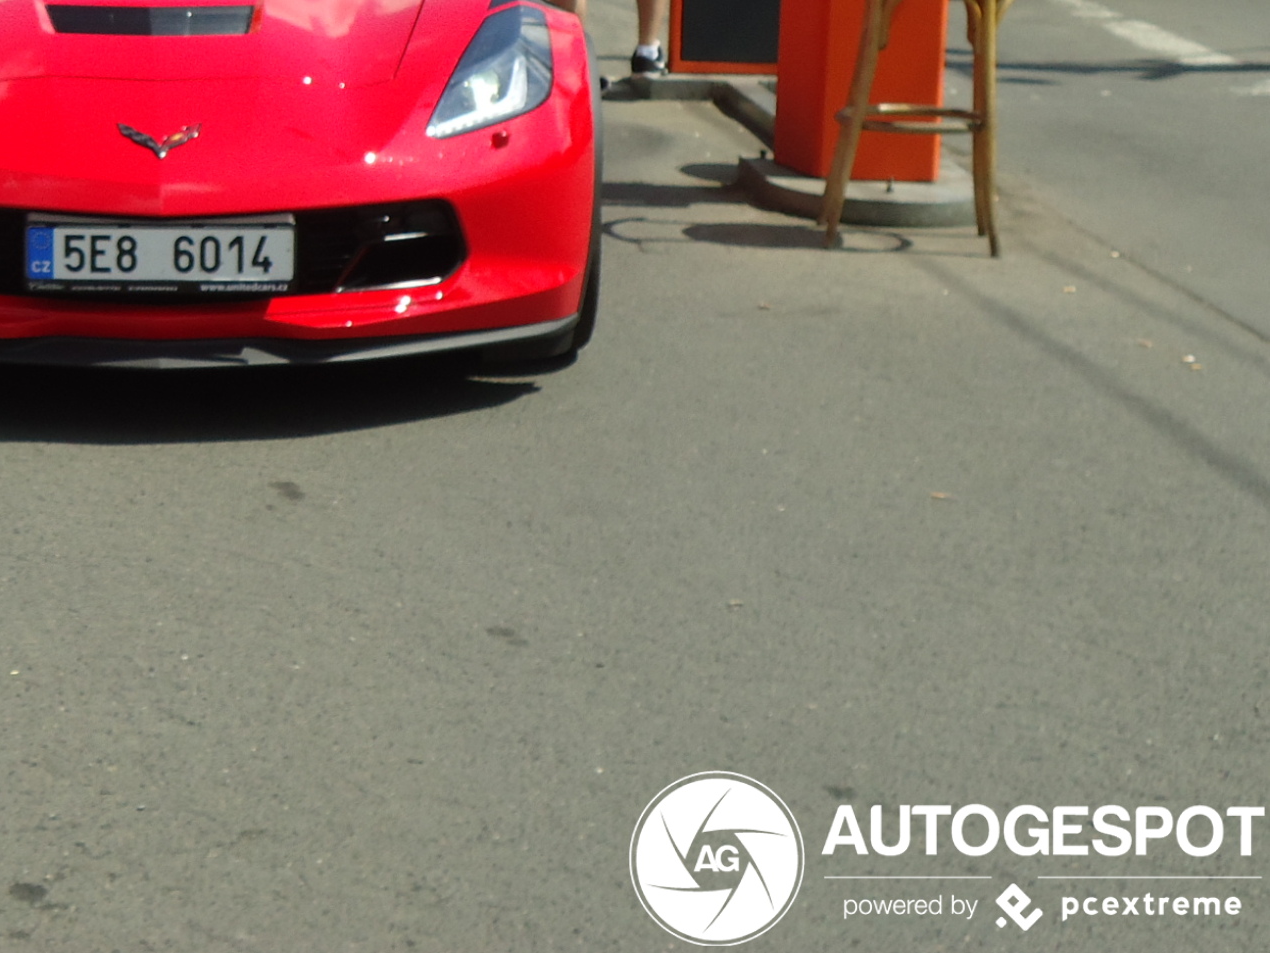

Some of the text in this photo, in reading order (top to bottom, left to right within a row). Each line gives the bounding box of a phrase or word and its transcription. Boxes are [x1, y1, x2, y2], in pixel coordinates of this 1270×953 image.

[31, 261, 51, 273] CZ
[64, 235, 273, 274] 5E8 6014
